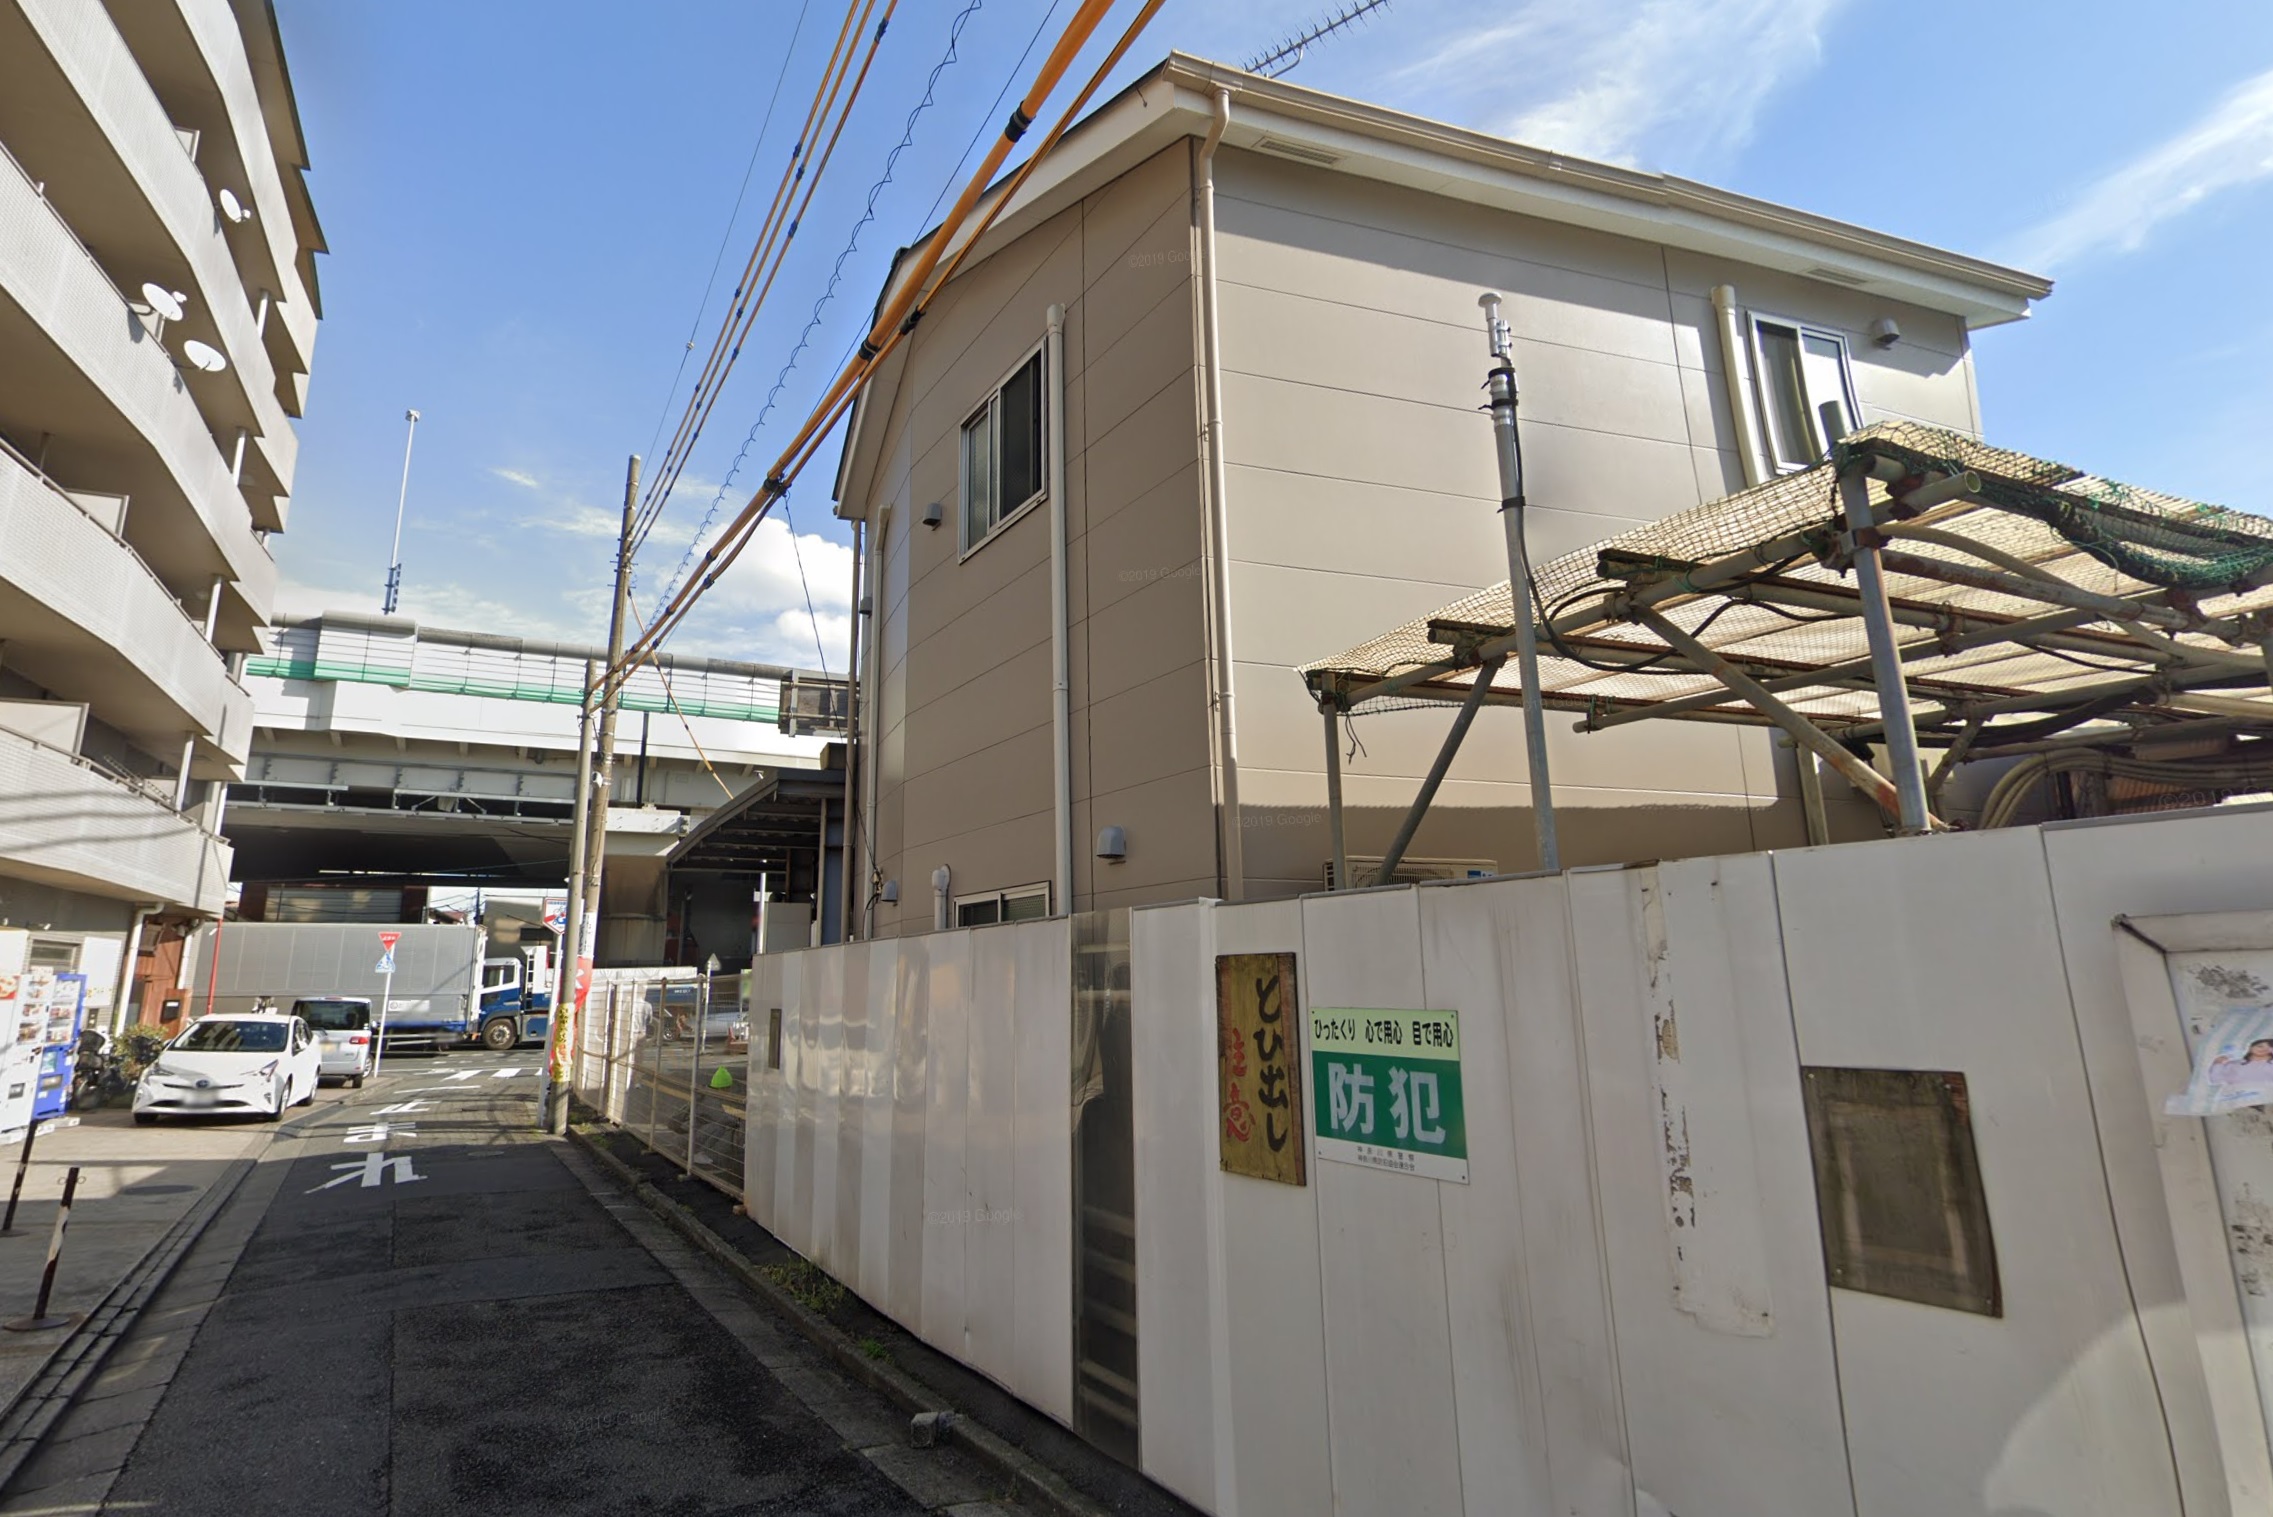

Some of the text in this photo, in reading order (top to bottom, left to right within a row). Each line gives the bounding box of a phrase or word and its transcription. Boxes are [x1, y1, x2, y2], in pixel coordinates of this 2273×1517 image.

[1314, 1018, 1454, 1048] ひったくり 心で用心 目で用心
[1327, 1061, 1447, 1145] 防犯
